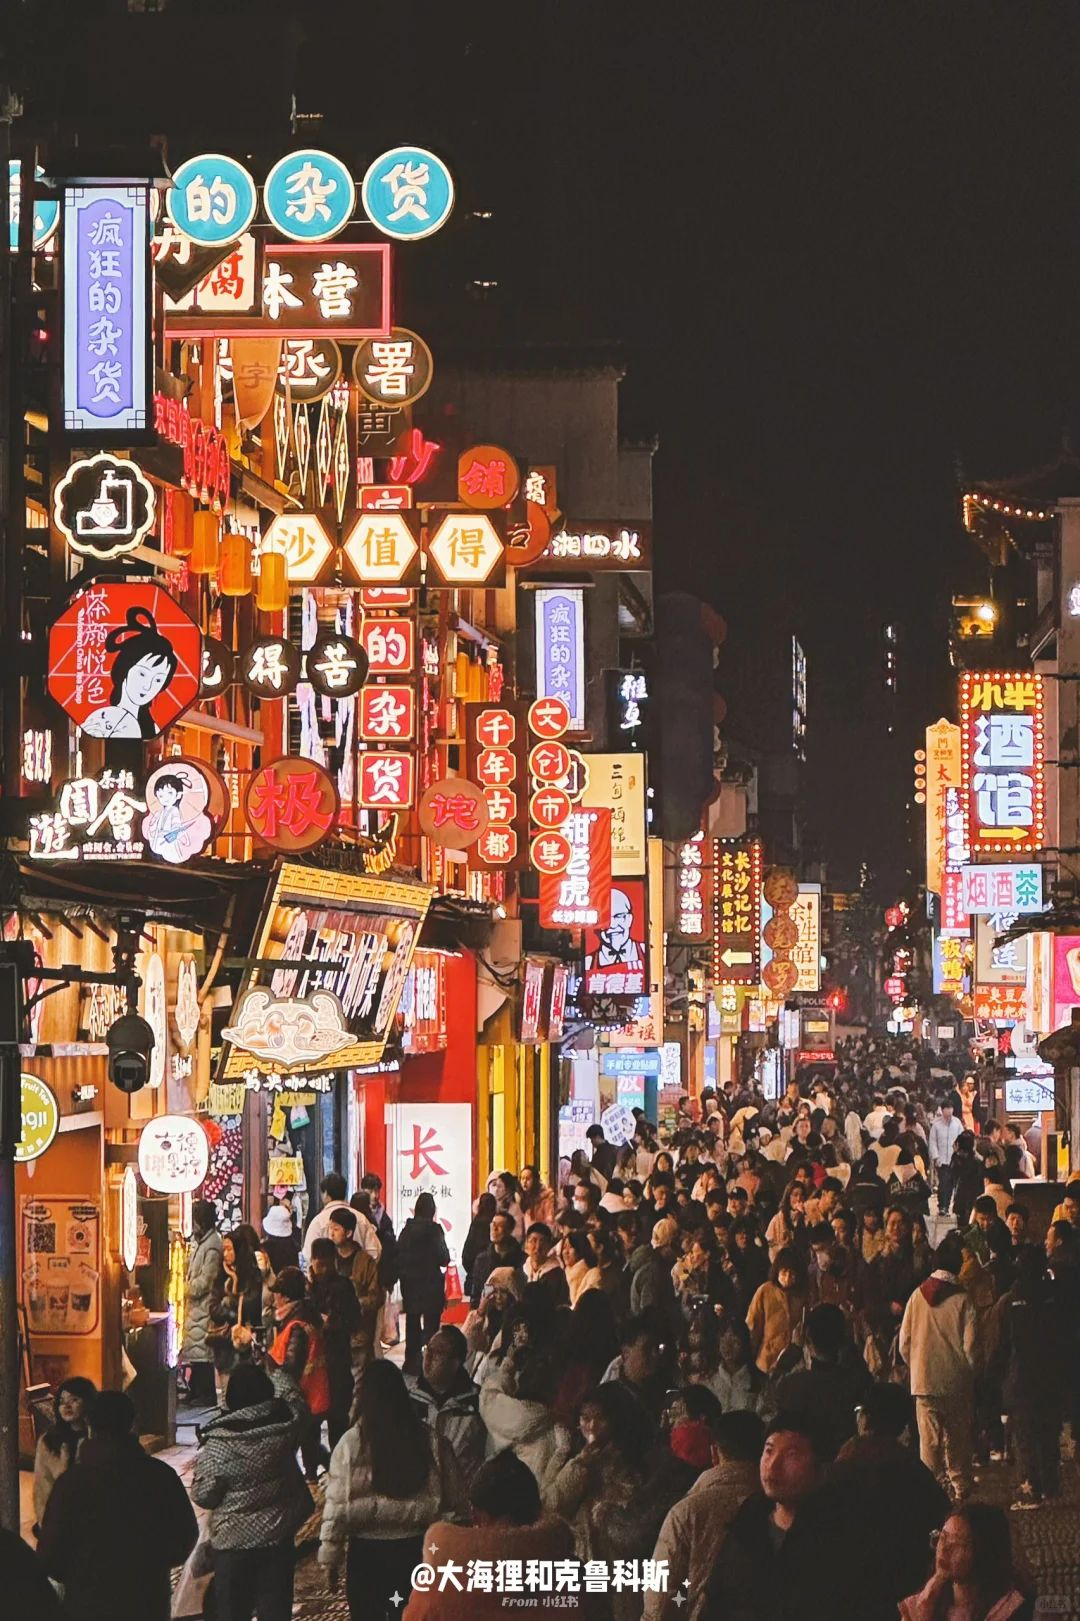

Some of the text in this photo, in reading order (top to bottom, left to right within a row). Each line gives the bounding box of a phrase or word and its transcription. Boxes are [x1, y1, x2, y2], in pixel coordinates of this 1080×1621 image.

[185, 161, 430, 224] 的杂货
[88, 212, 123, 402] 疯狂的杂货
[543, 530, 642, 560] 湘四水
[971, 681, 1036, 711] 小半
[248, 768, 331, 838] 极
[482, 714, 511, 859] 千年古都
[535, 703, 567, 868] 文创市集
[973, 714, 1034, 826] 酒馆
[680, 843, 703, 934] 长沙米酒
[733, 850, 752, 934] 长沙记忆
[966, 869, 1039, 908] 烟酒茶
[588, 972, 644, 994] 肯德基
[400, 1124, 450, 1180] 长
